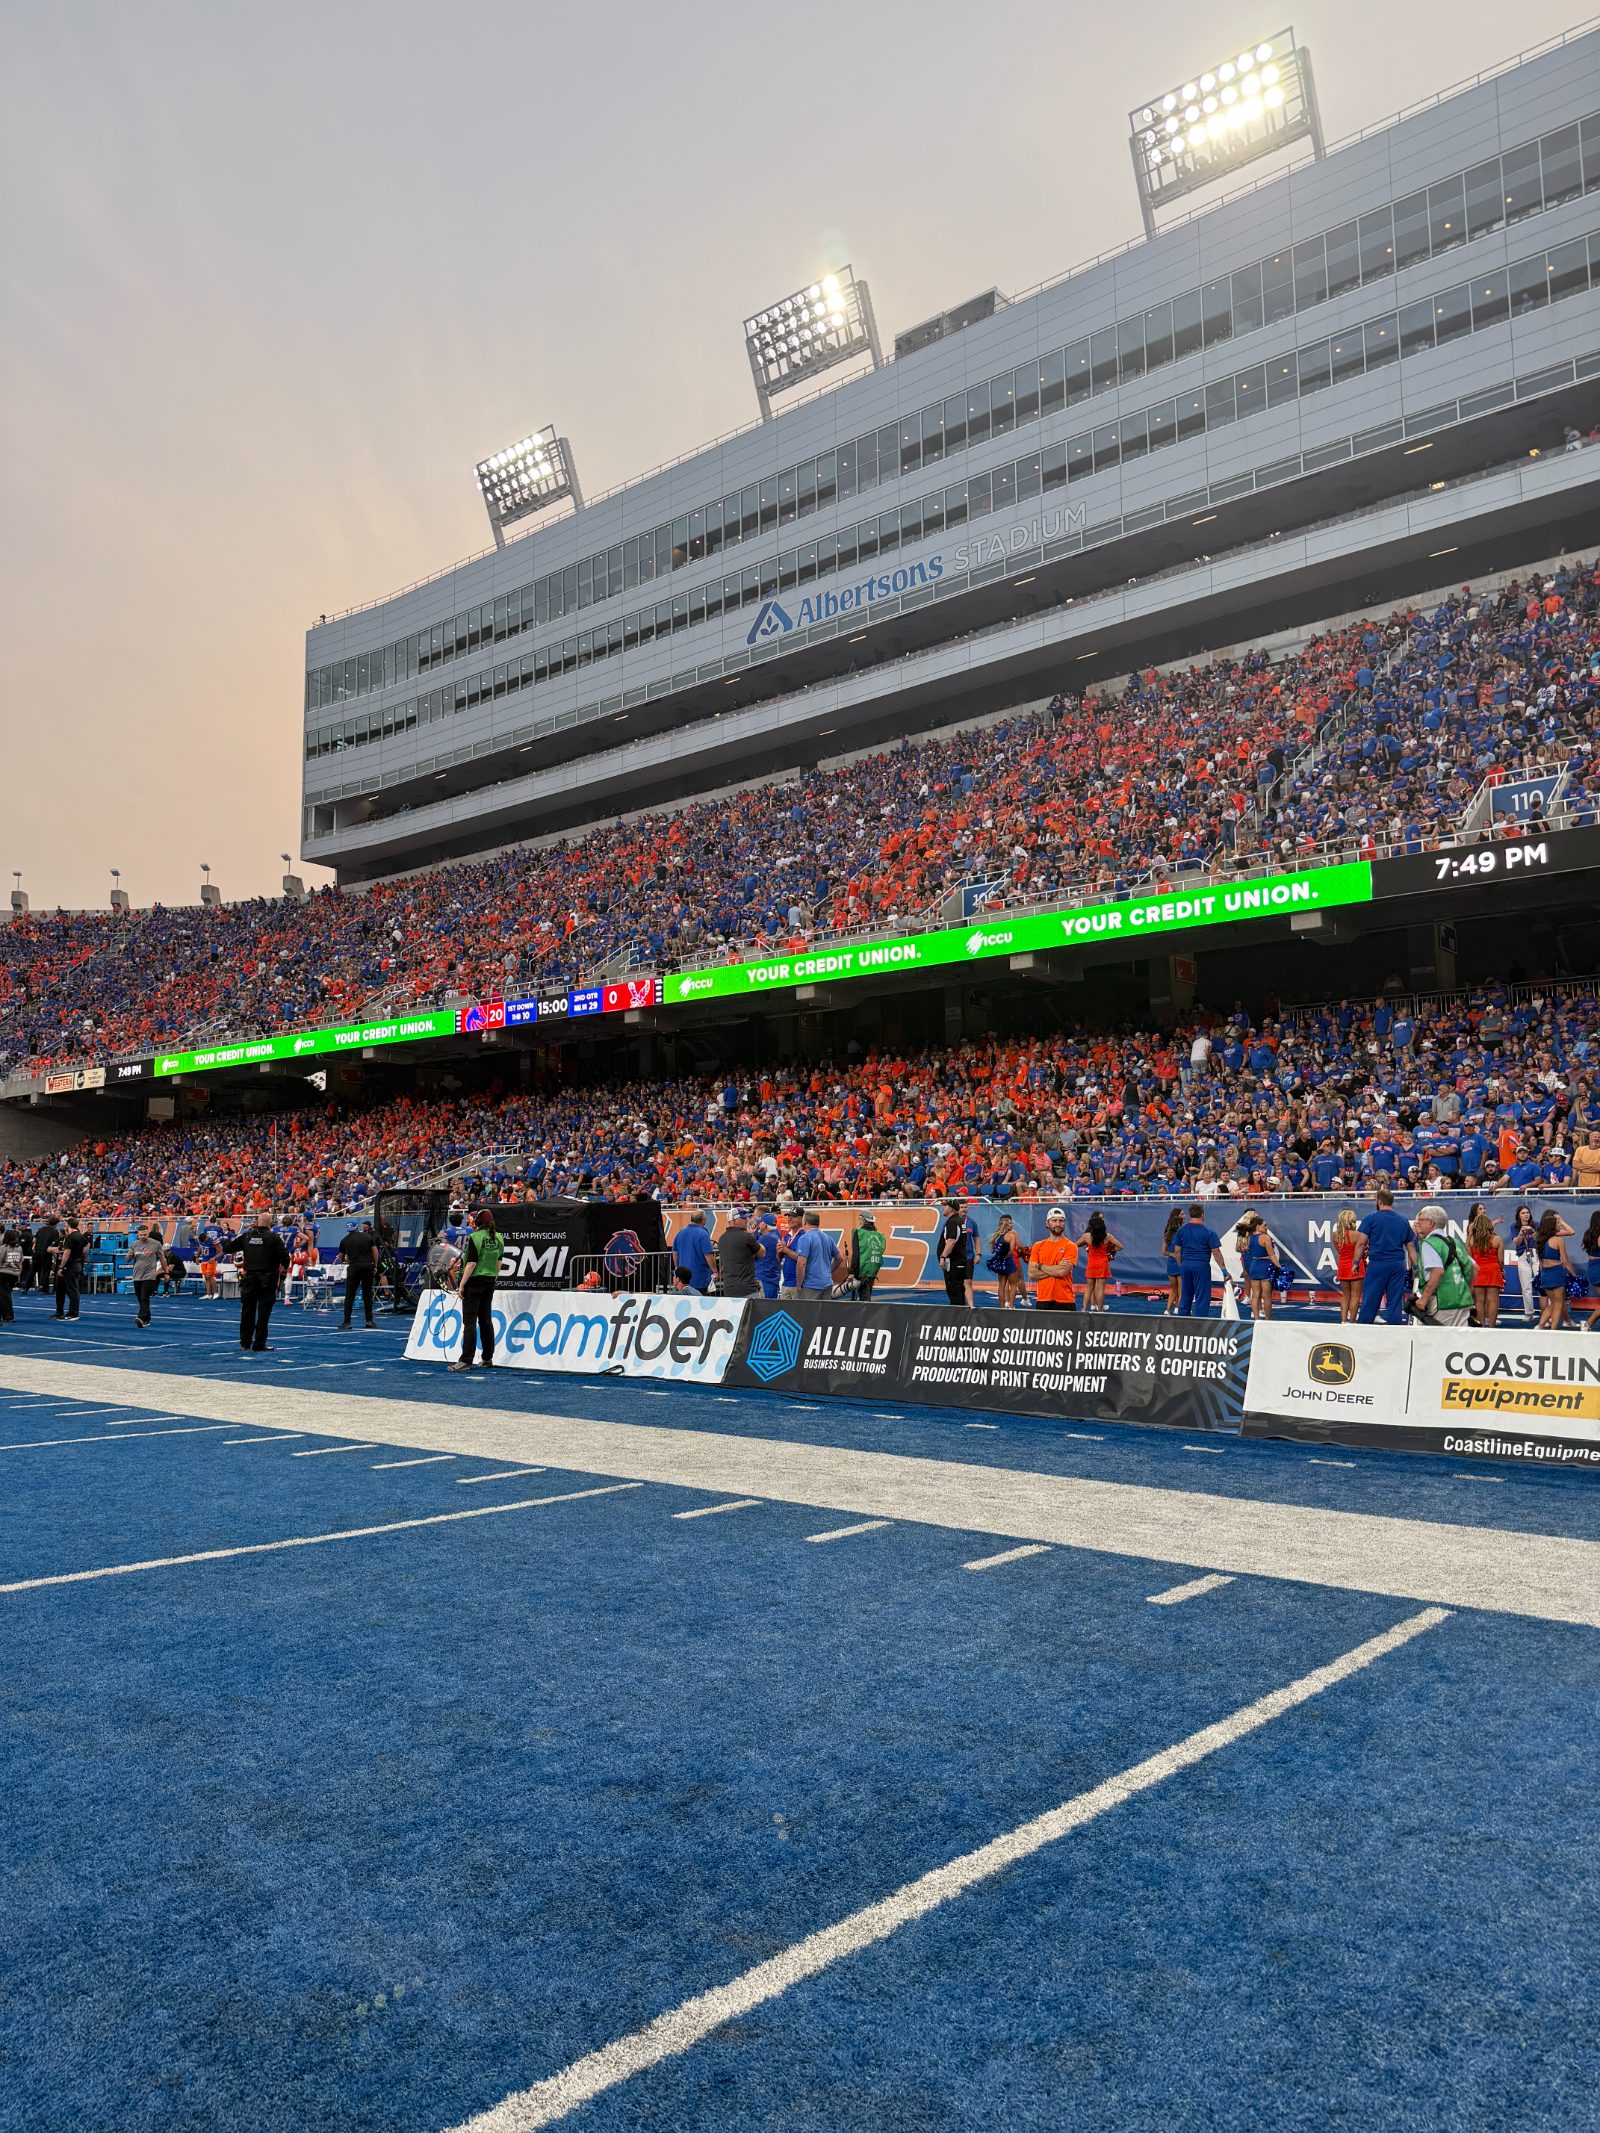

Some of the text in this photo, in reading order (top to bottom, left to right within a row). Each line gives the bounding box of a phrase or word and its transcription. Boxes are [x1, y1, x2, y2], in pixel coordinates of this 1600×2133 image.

[796, 502, 1087, 627] Albertsons STADIUM
[1511, 789, 1544, 811] 110
[1435, 842, 1547, 880] 7:49 PM
[1061, 881, 1319, 936] YOUR CREDIT UNION.
[982, 932, 1013, 947] ICCU
[747, 944, 922, 984] YOUR CREDIT UNION.
[537, 998, 568, 1015] 15:00
[609, 991, 617, 1004] 0
[490, 1009, 503, 1022] 20
[334, 1020, 436, 1045] YOUR CREDIT UNION.
[194, 1044, 275, 1066] YOUR CREDIT UNION.
[512, 1232, 529, 1240] TEAM
[530, 1231, 566, 1240] PHYSICIANS
[499, 1246, 570, 1277] SMI
[806, 1326, 892, 1360] ALLIED
[919, 1324, 1238, 1356] IT AND CLOUD SOLUTIONS SECURITY SOLUTIONS
[803, 1359, 887, 1375] BUSINESS SOLUTIONS
[915, 1345, 1227, 1380] AUTOMATION SOLUTIONS PRINTERS & COPIERS
[911, 1365, 1107, 1393] PRODUCTION PRINT EQUIPMENT
[1282, 1386, 1375, 1406] JOHN DEERE
[1444, 1382, 1585, 1411] Equipment
